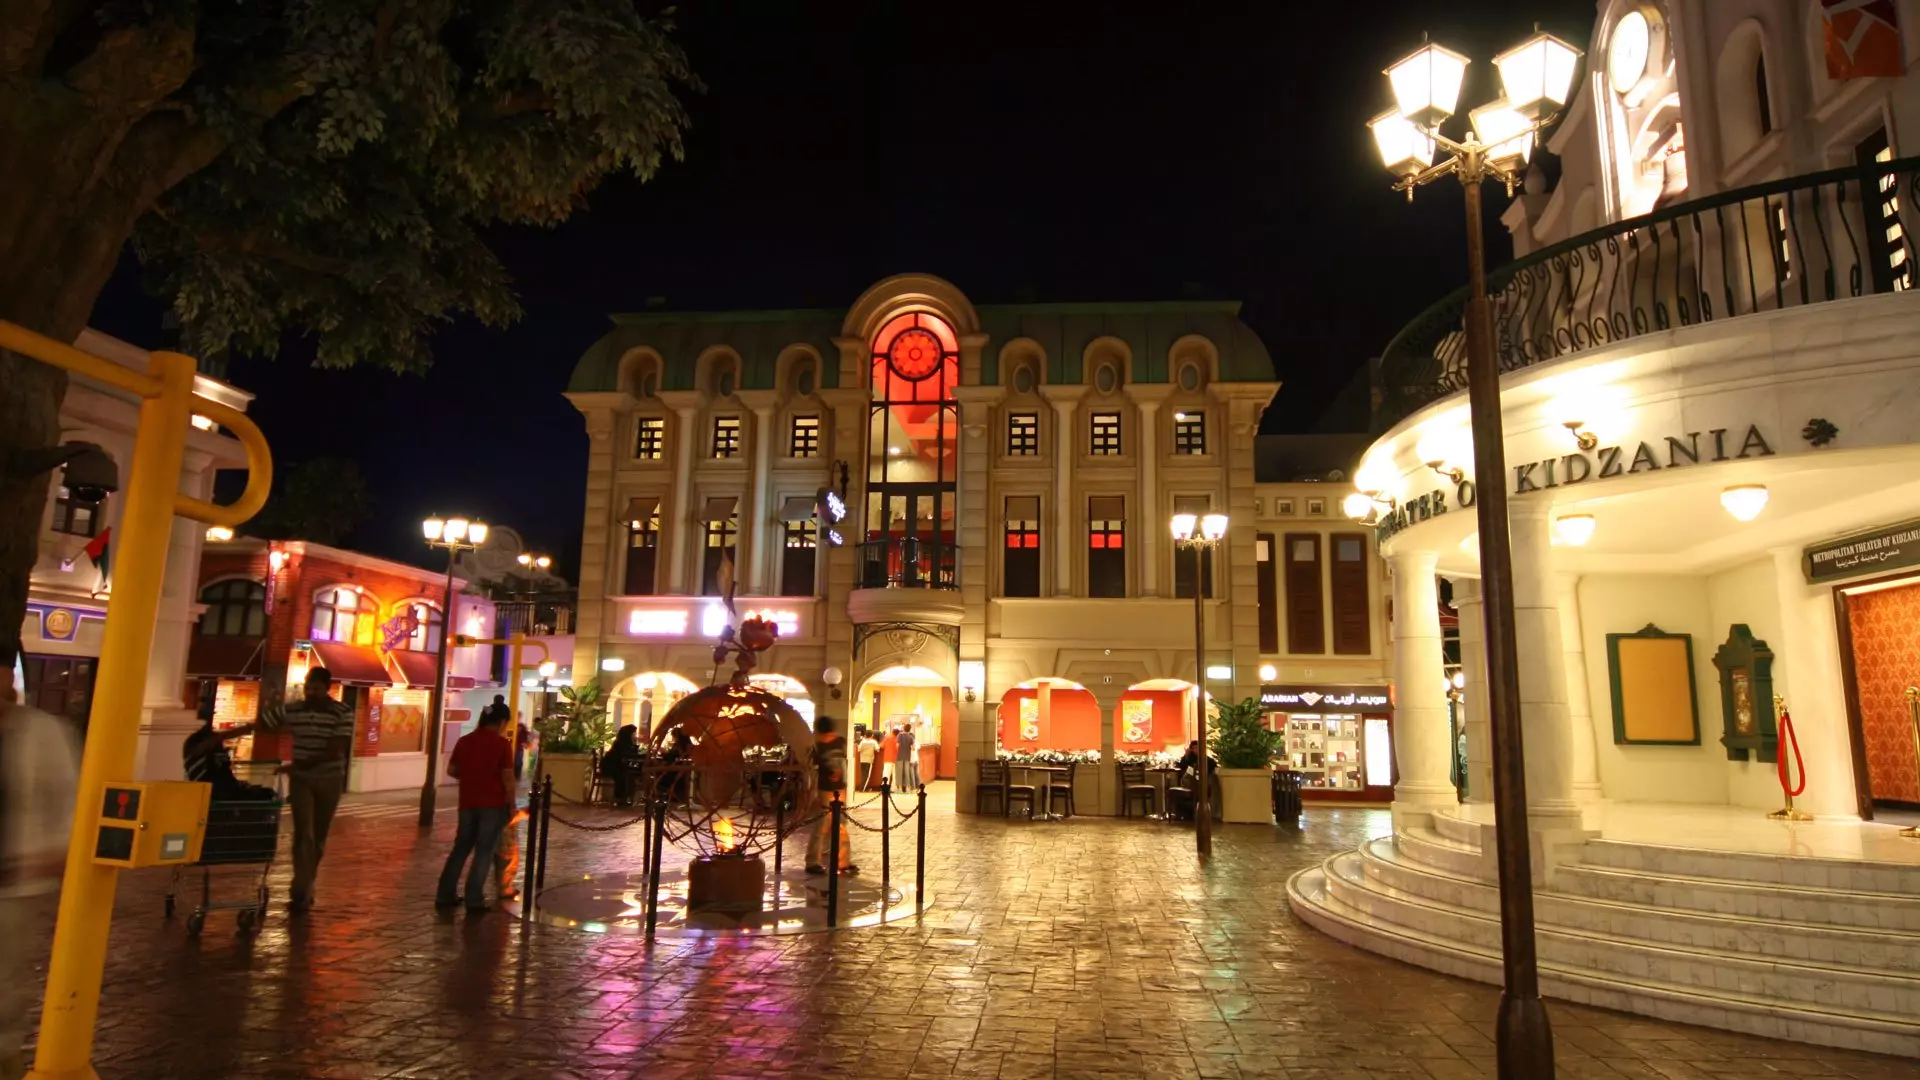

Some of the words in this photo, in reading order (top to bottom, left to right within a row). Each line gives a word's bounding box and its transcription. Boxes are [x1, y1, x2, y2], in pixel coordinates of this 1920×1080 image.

[1457, 480, 1475, 508] O
[1513, 424, 1776, 494] KIDZANIA
[1855, 538, 1882, 553] THEATER
[1882, 536, 1891, 547] OF
[1891, 529, 1920, 545] KIDZANI
[1261, 693, 1299, 703] ARABIAN
